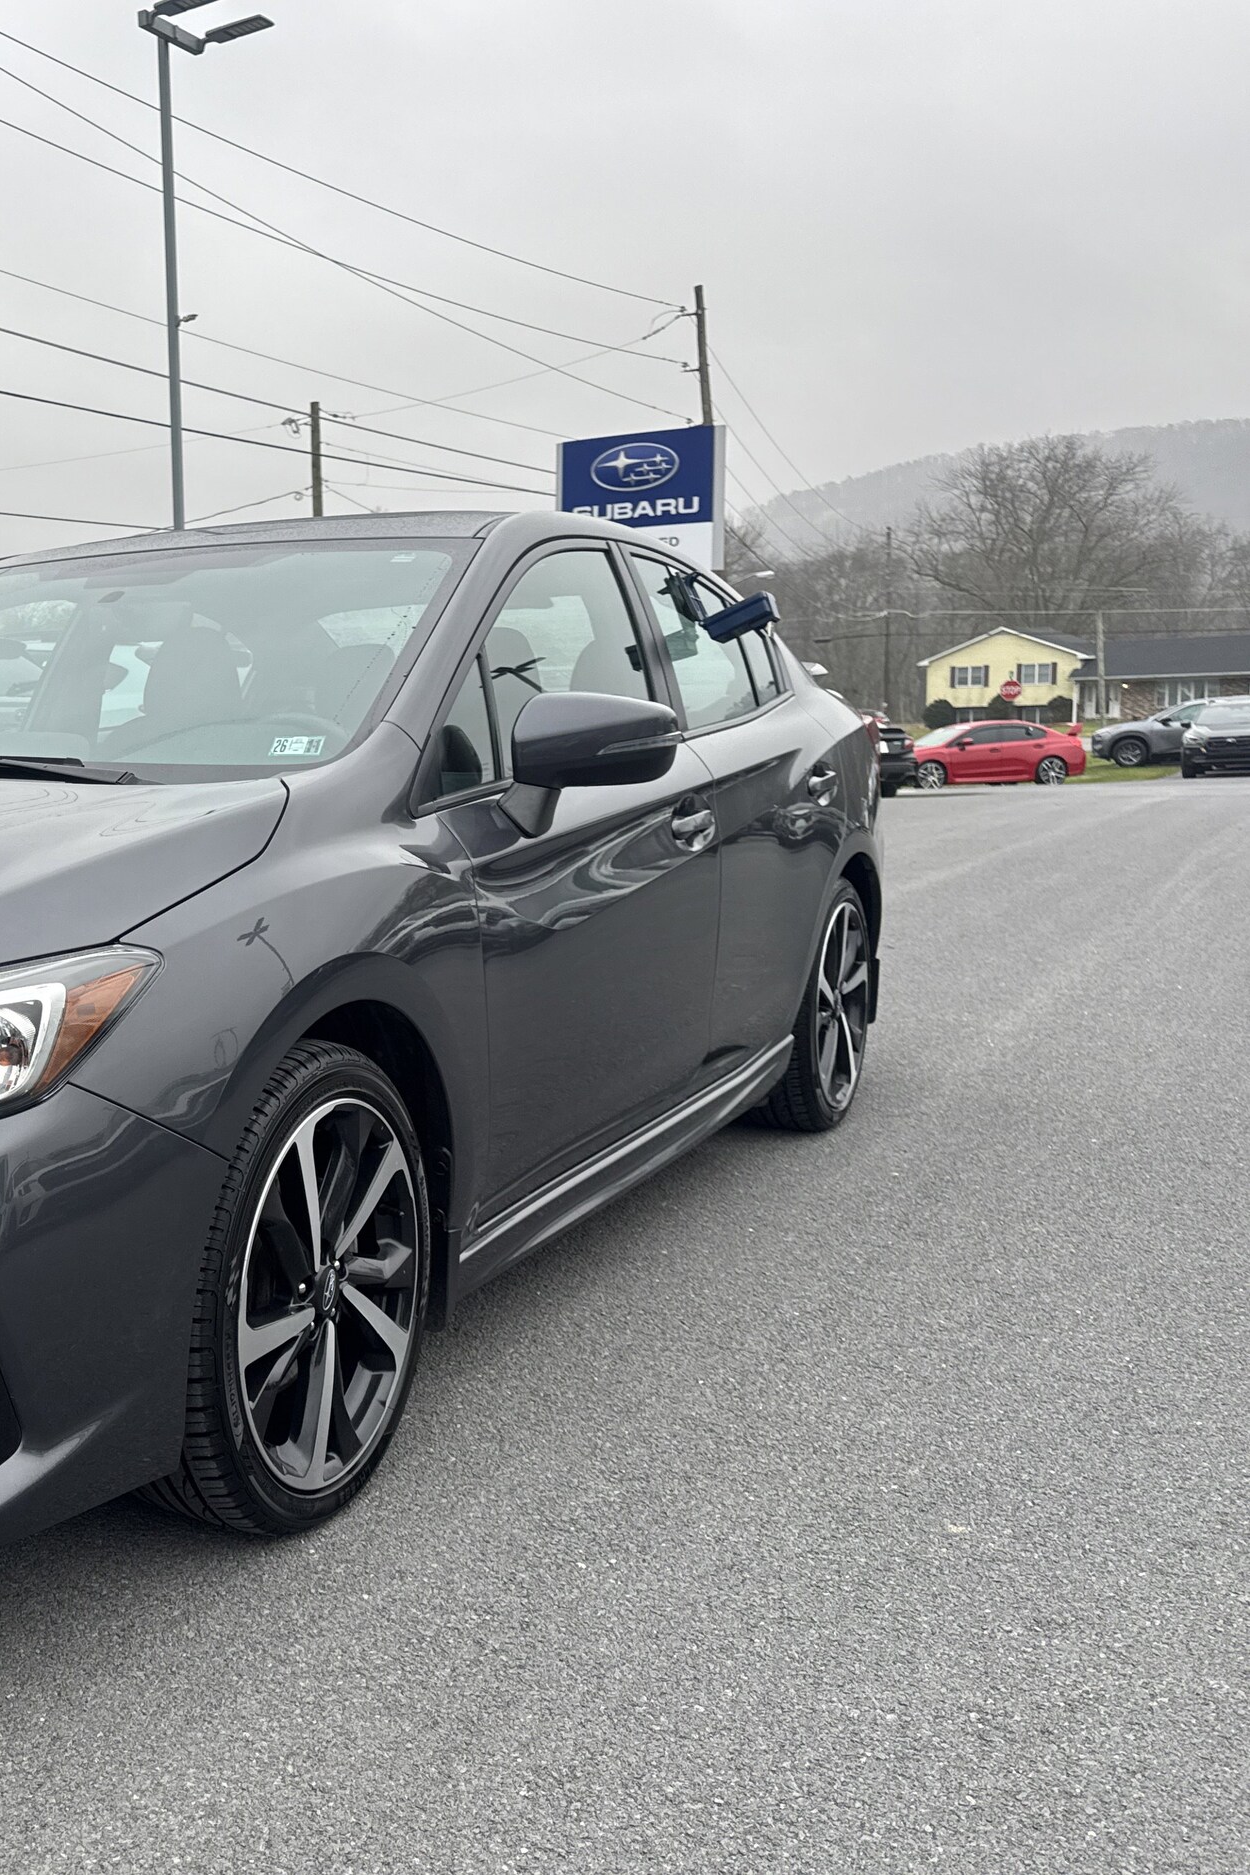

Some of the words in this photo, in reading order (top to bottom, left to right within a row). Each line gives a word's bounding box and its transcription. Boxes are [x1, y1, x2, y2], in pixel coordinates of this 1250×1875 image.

[572, 496, 700, 520] SUBARU
[1001, 685, 1021, 695] STOP
[273, 739, 289, 753] 26
